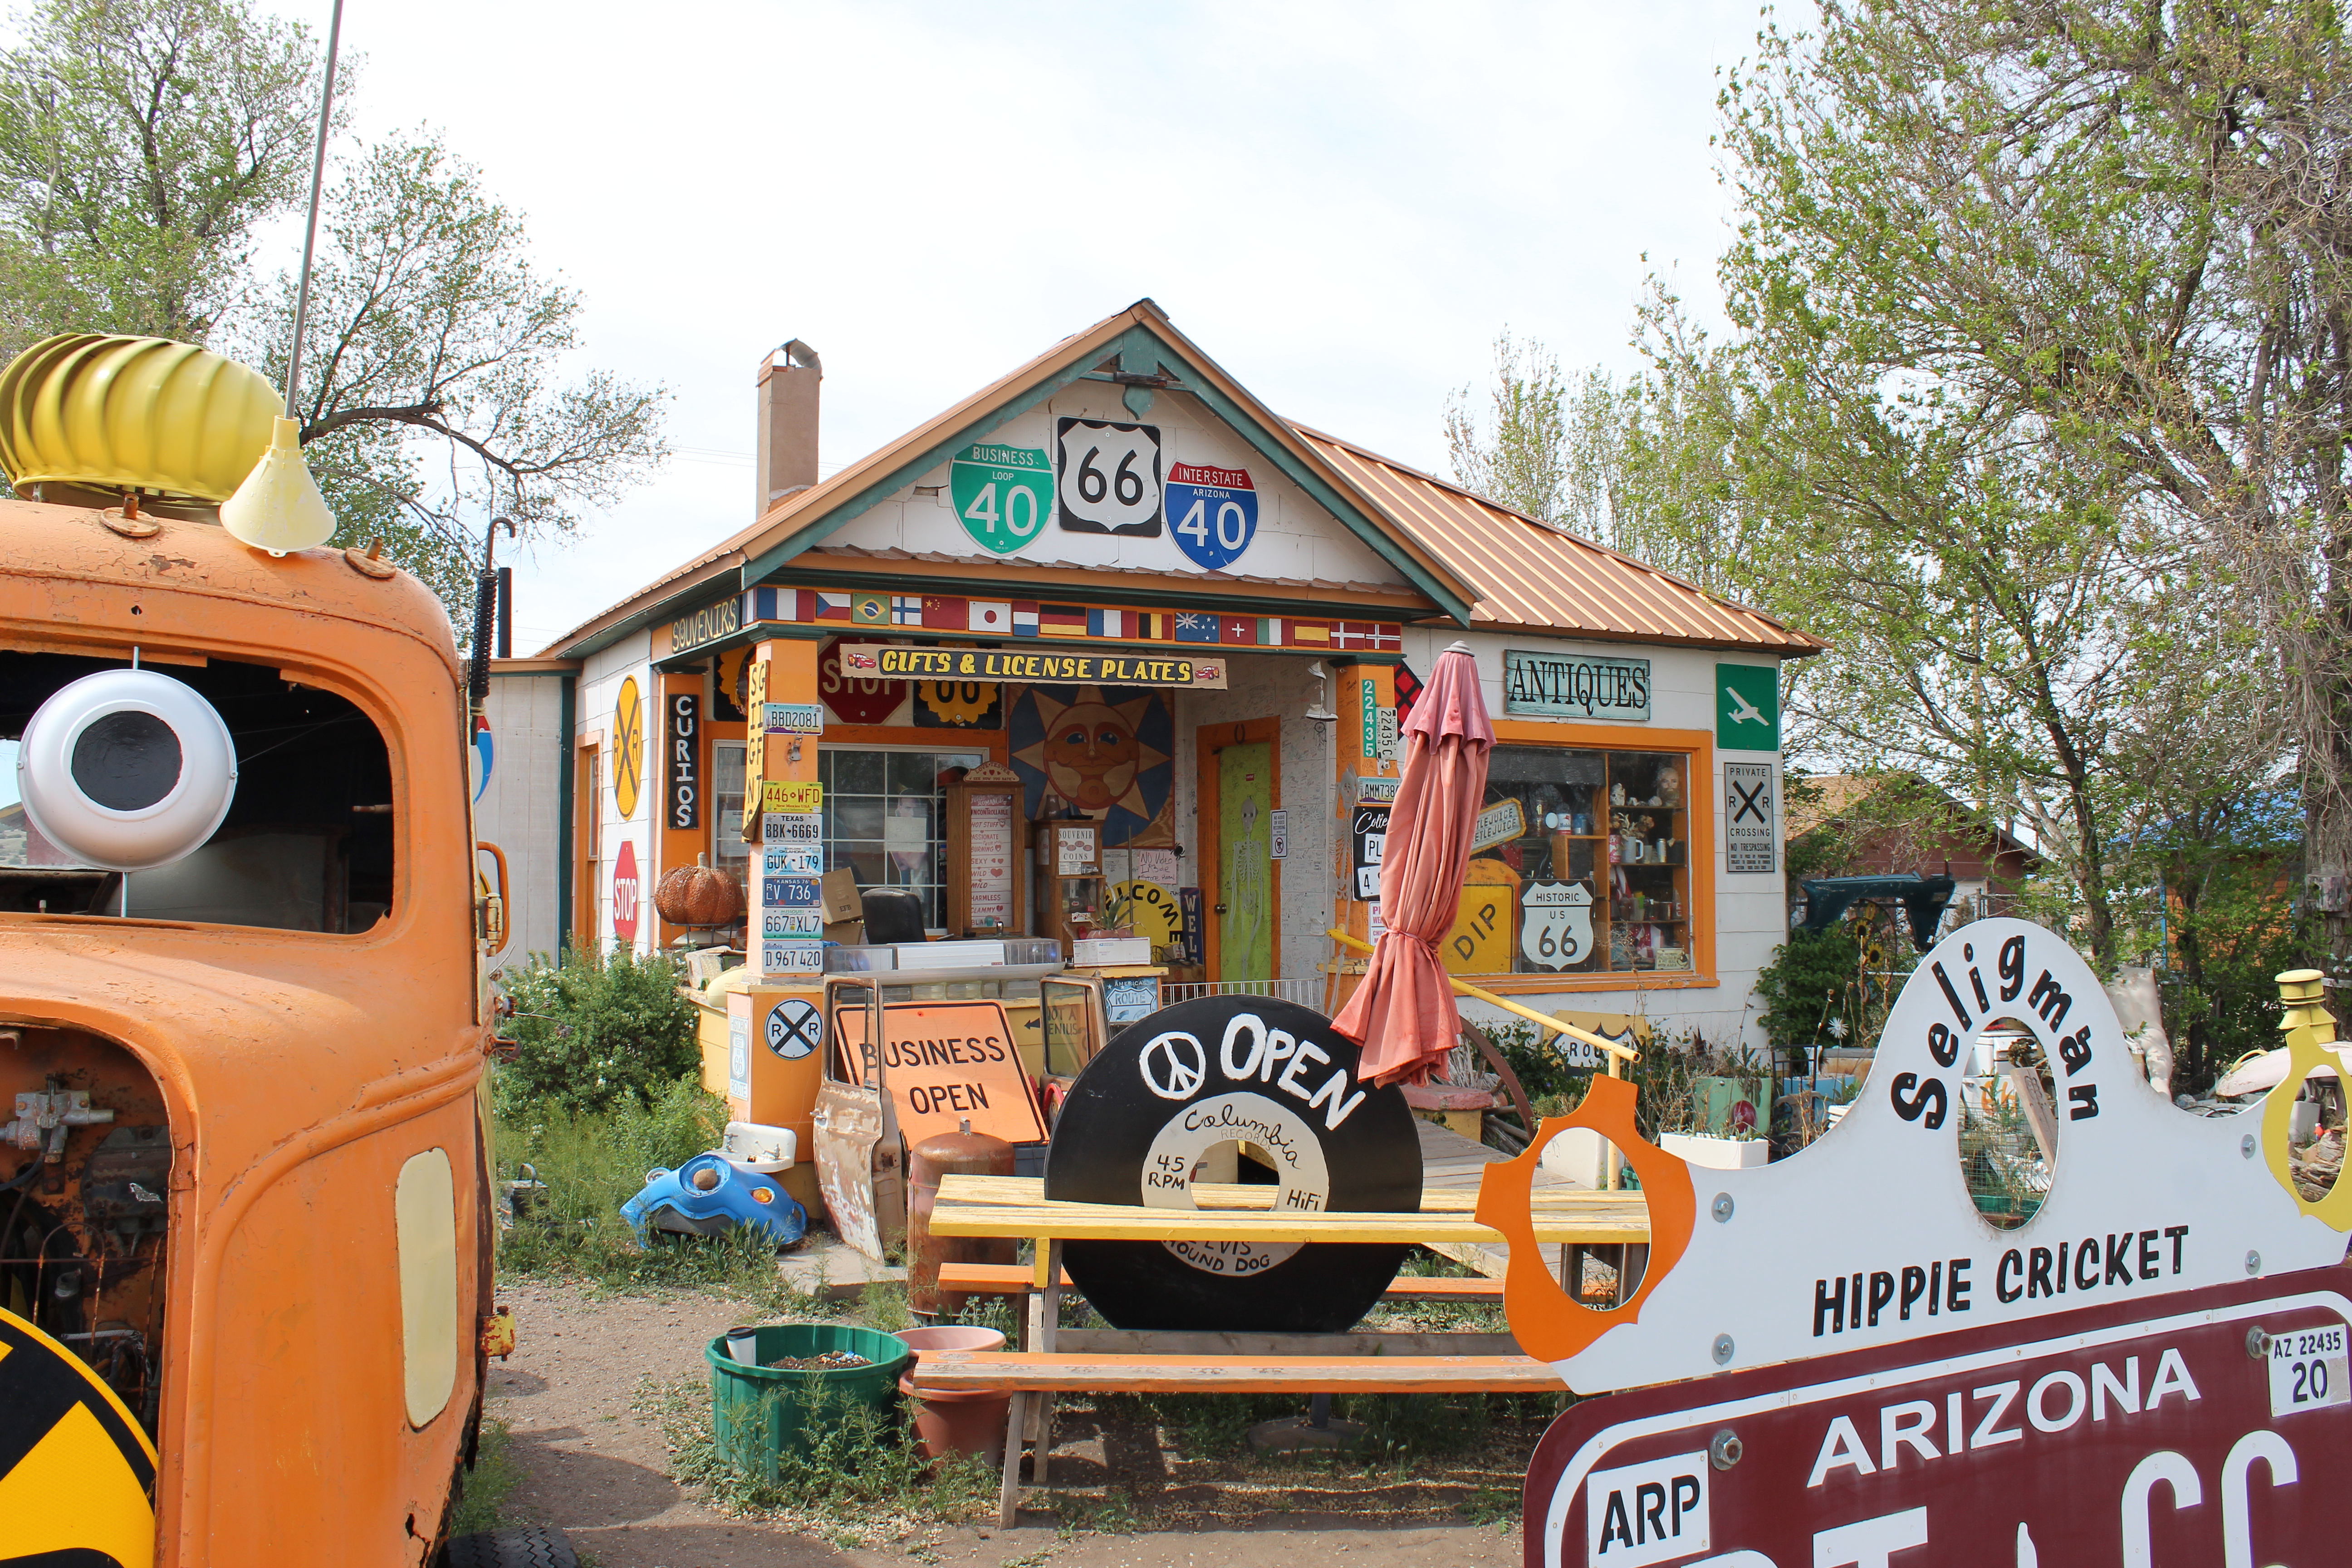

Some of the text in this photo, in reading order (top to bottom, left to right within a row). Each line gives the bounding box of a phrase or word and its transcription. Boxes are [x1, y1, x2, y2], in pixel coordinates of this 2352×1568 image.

[973, 446, 1034, 466] BUSINESS
[992, 471, 1014, 481] LOOP
[1078, 446, 1143, 506] 66
[1179, 467, 1243, 486] INTERSTATE
[1193, 488, 1230, 499] ARIZONA
[965, 482, 1038, 537] 40
[1177, 499, 1246, 550] 40
[672, 598, 737, 652] SOUVENIRS
[882, 650, 1191, 681] GIFTS & LICENSE PLATES
[1509, 659, 1647, 716] ANTIQUES
[772, 711, 818, 727] BBD2081
[1364, 680, 1374, 757] 22435
[1381, 710, 1392, 746] 22435
[676, 696, 694, 827] CURIOS
[975, 762, 1010, 775] LOVE TESTER
[1730, 767, 1766, 777] PRIVATE
[767, 788, 819, 803] 446 WFD
[978, 797, 1004, 806] ROMANCE
[1729, 796, 1769, 808] R R
[766, 824, 818, 838] BBK 6669
[1058, 830, 1093, 839] SOUVENIR
[1473, 818, 1516, 843] ETLEJUICE
[1730, 828, 1770, 837] CROSSING
[1730, 843, 1770, 851] NO TRESPASSING
[767, 855, 819, 869] GUK 179
[1364, 873, 1370, 890] 4
[614, 874, 637, 922] STOP
[789, 885, 811, 900] 736
[1536, 892, 1580, 902] HISTORIC
[766, 916, 789, 931] 667
[796, 916, 820, 932] XL7
[1453, 903, 1496, 961] DIP
[1539, 924, 1578, 957] 66
[766, 951, 820, 966] D 967 420
[1115, 992, 1146, 1005] ROUTE
[771, 1023, 818, 1037] R R
[1891, 934, 2098, 1131] Seligman
[859, 1036, 1004, 1069] BUSINESS
[734, 1056, 743, 1073] 66
[1220, 1013, 1366, 1131] OPEN
[731, 1081, 747, 1096] ROUTE
[909, 1083, 990, 1115] OPEN
[1184, 1104, 1302, 1170] Columbia
[1220, 1128, 1271, 1151] RECORDS
[1157, 1154, 1185, 1172] 45
[1148, 1172, 1185, 1190] RPM
[1287, 1189, 1321, 1211] HiFi
[1235, 1254, 1270, 1272] DOG
[1813, 1225, 2189, 1337] HIPPIE CRICKET
[2274, 1332, 2341, 1359] AZ 22435
[2292, 1359, 2328, 1403] 20
[1807, 1347, 2203, 1489] ARIZONA
[1598, 1475, 1700, 1555] ARP
